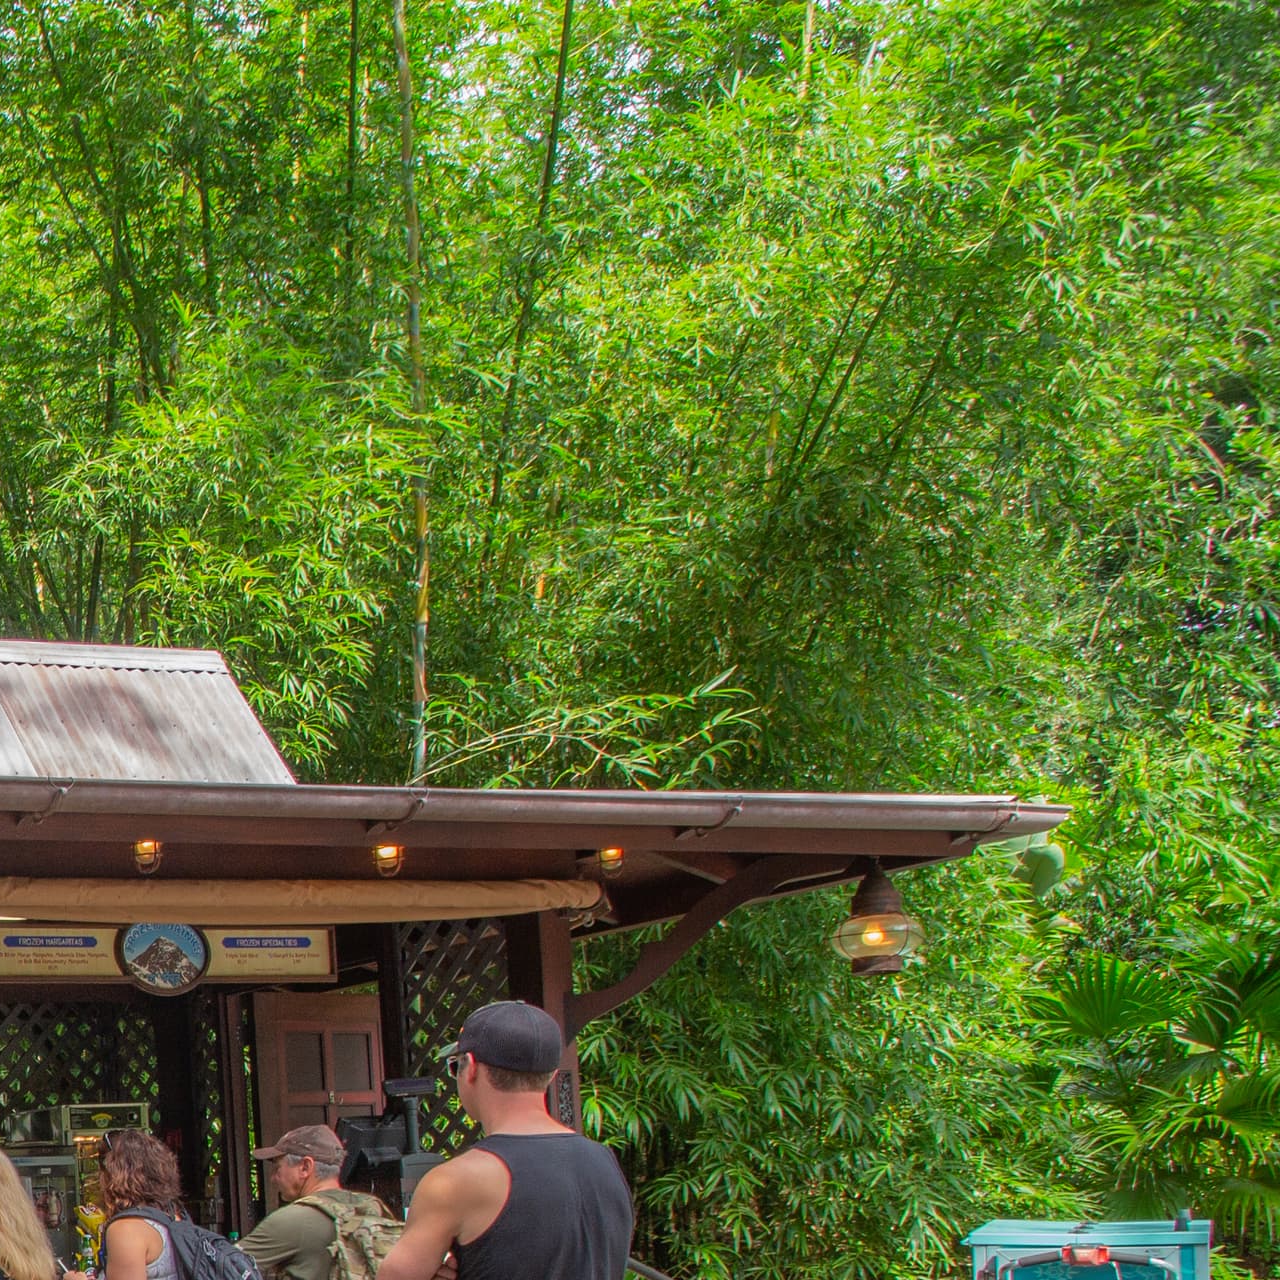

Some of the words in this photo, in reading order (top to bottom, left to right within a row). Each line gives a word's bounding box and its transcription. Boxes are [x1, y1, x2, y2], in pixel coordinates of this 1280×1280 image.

[18, 937, 45, 947] FROZEN
[45, 937, 84, 946] MARGARITAS
[236, 938, 260, 947] FROZEN
